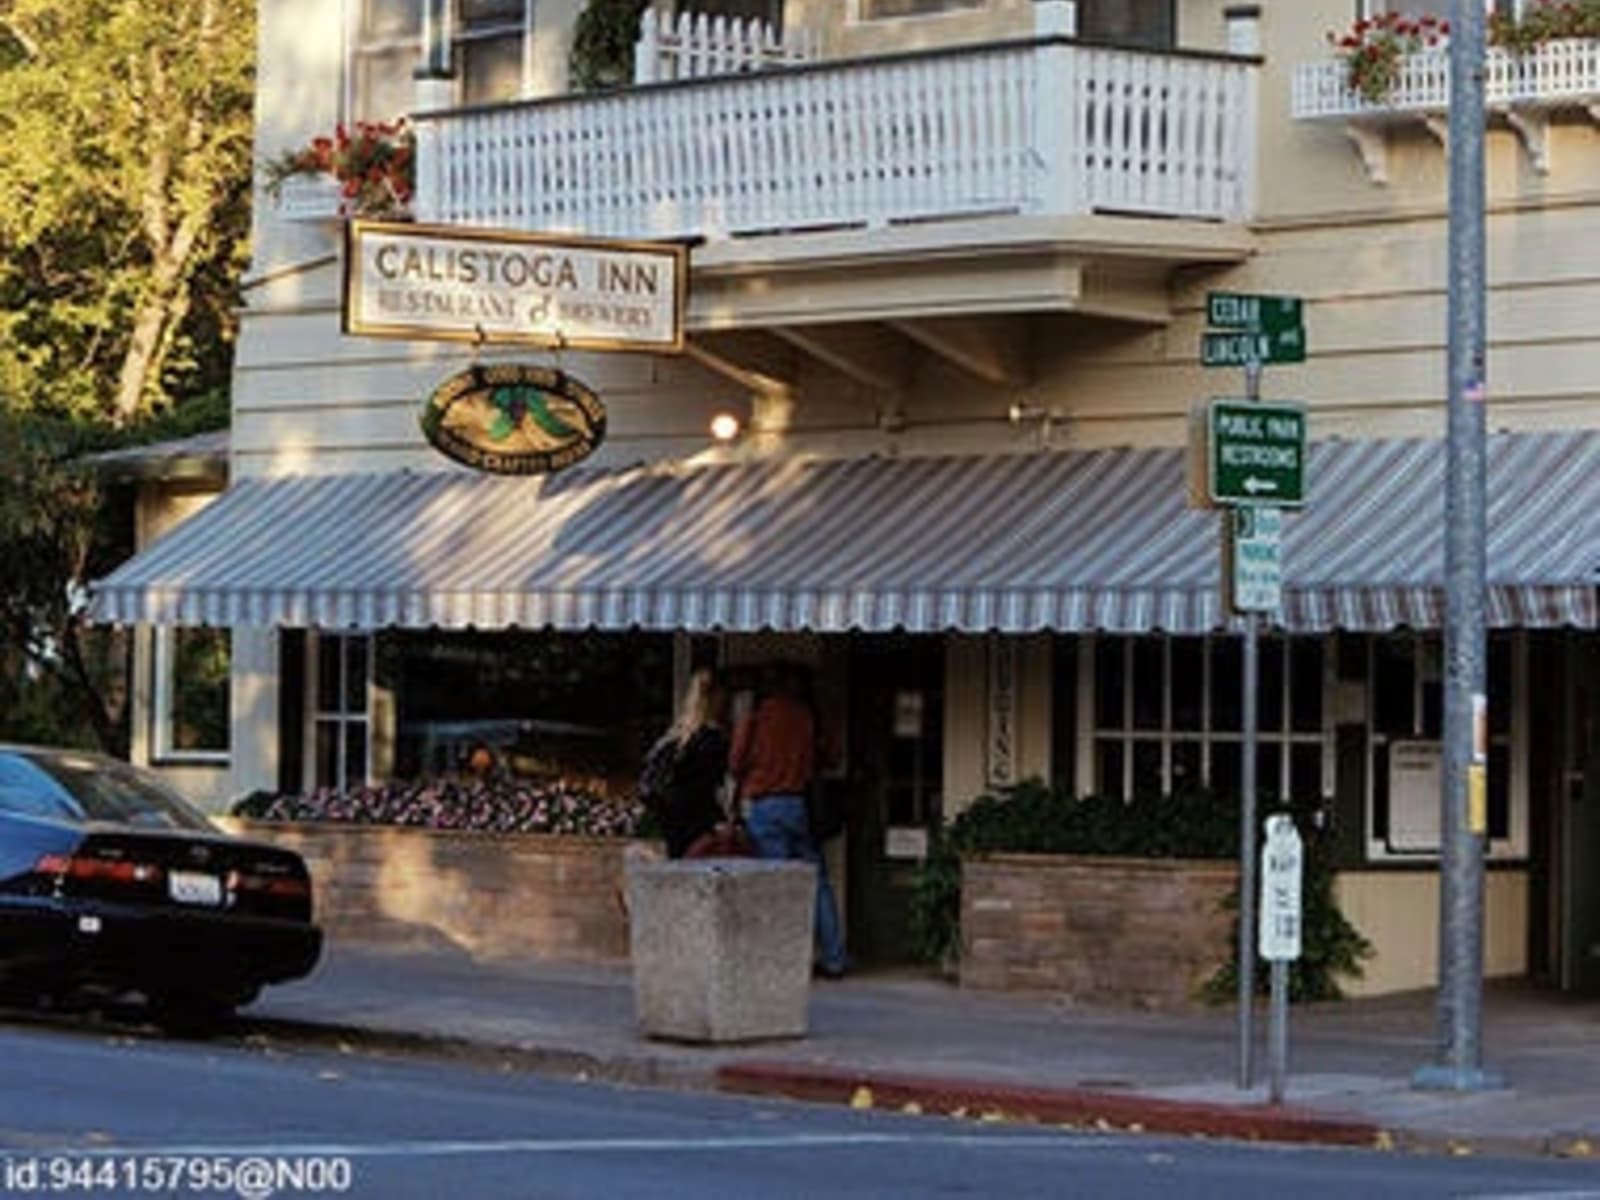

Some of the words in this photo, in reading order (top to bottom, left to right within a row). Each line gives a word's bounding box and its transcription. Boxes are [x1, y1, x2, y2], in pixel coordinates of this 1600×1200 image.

[376, 245, 579, 290] CALISTOGA
[598, 260, 658, 295] INN
[1202, 334, 1270, 363] LINCOLN
